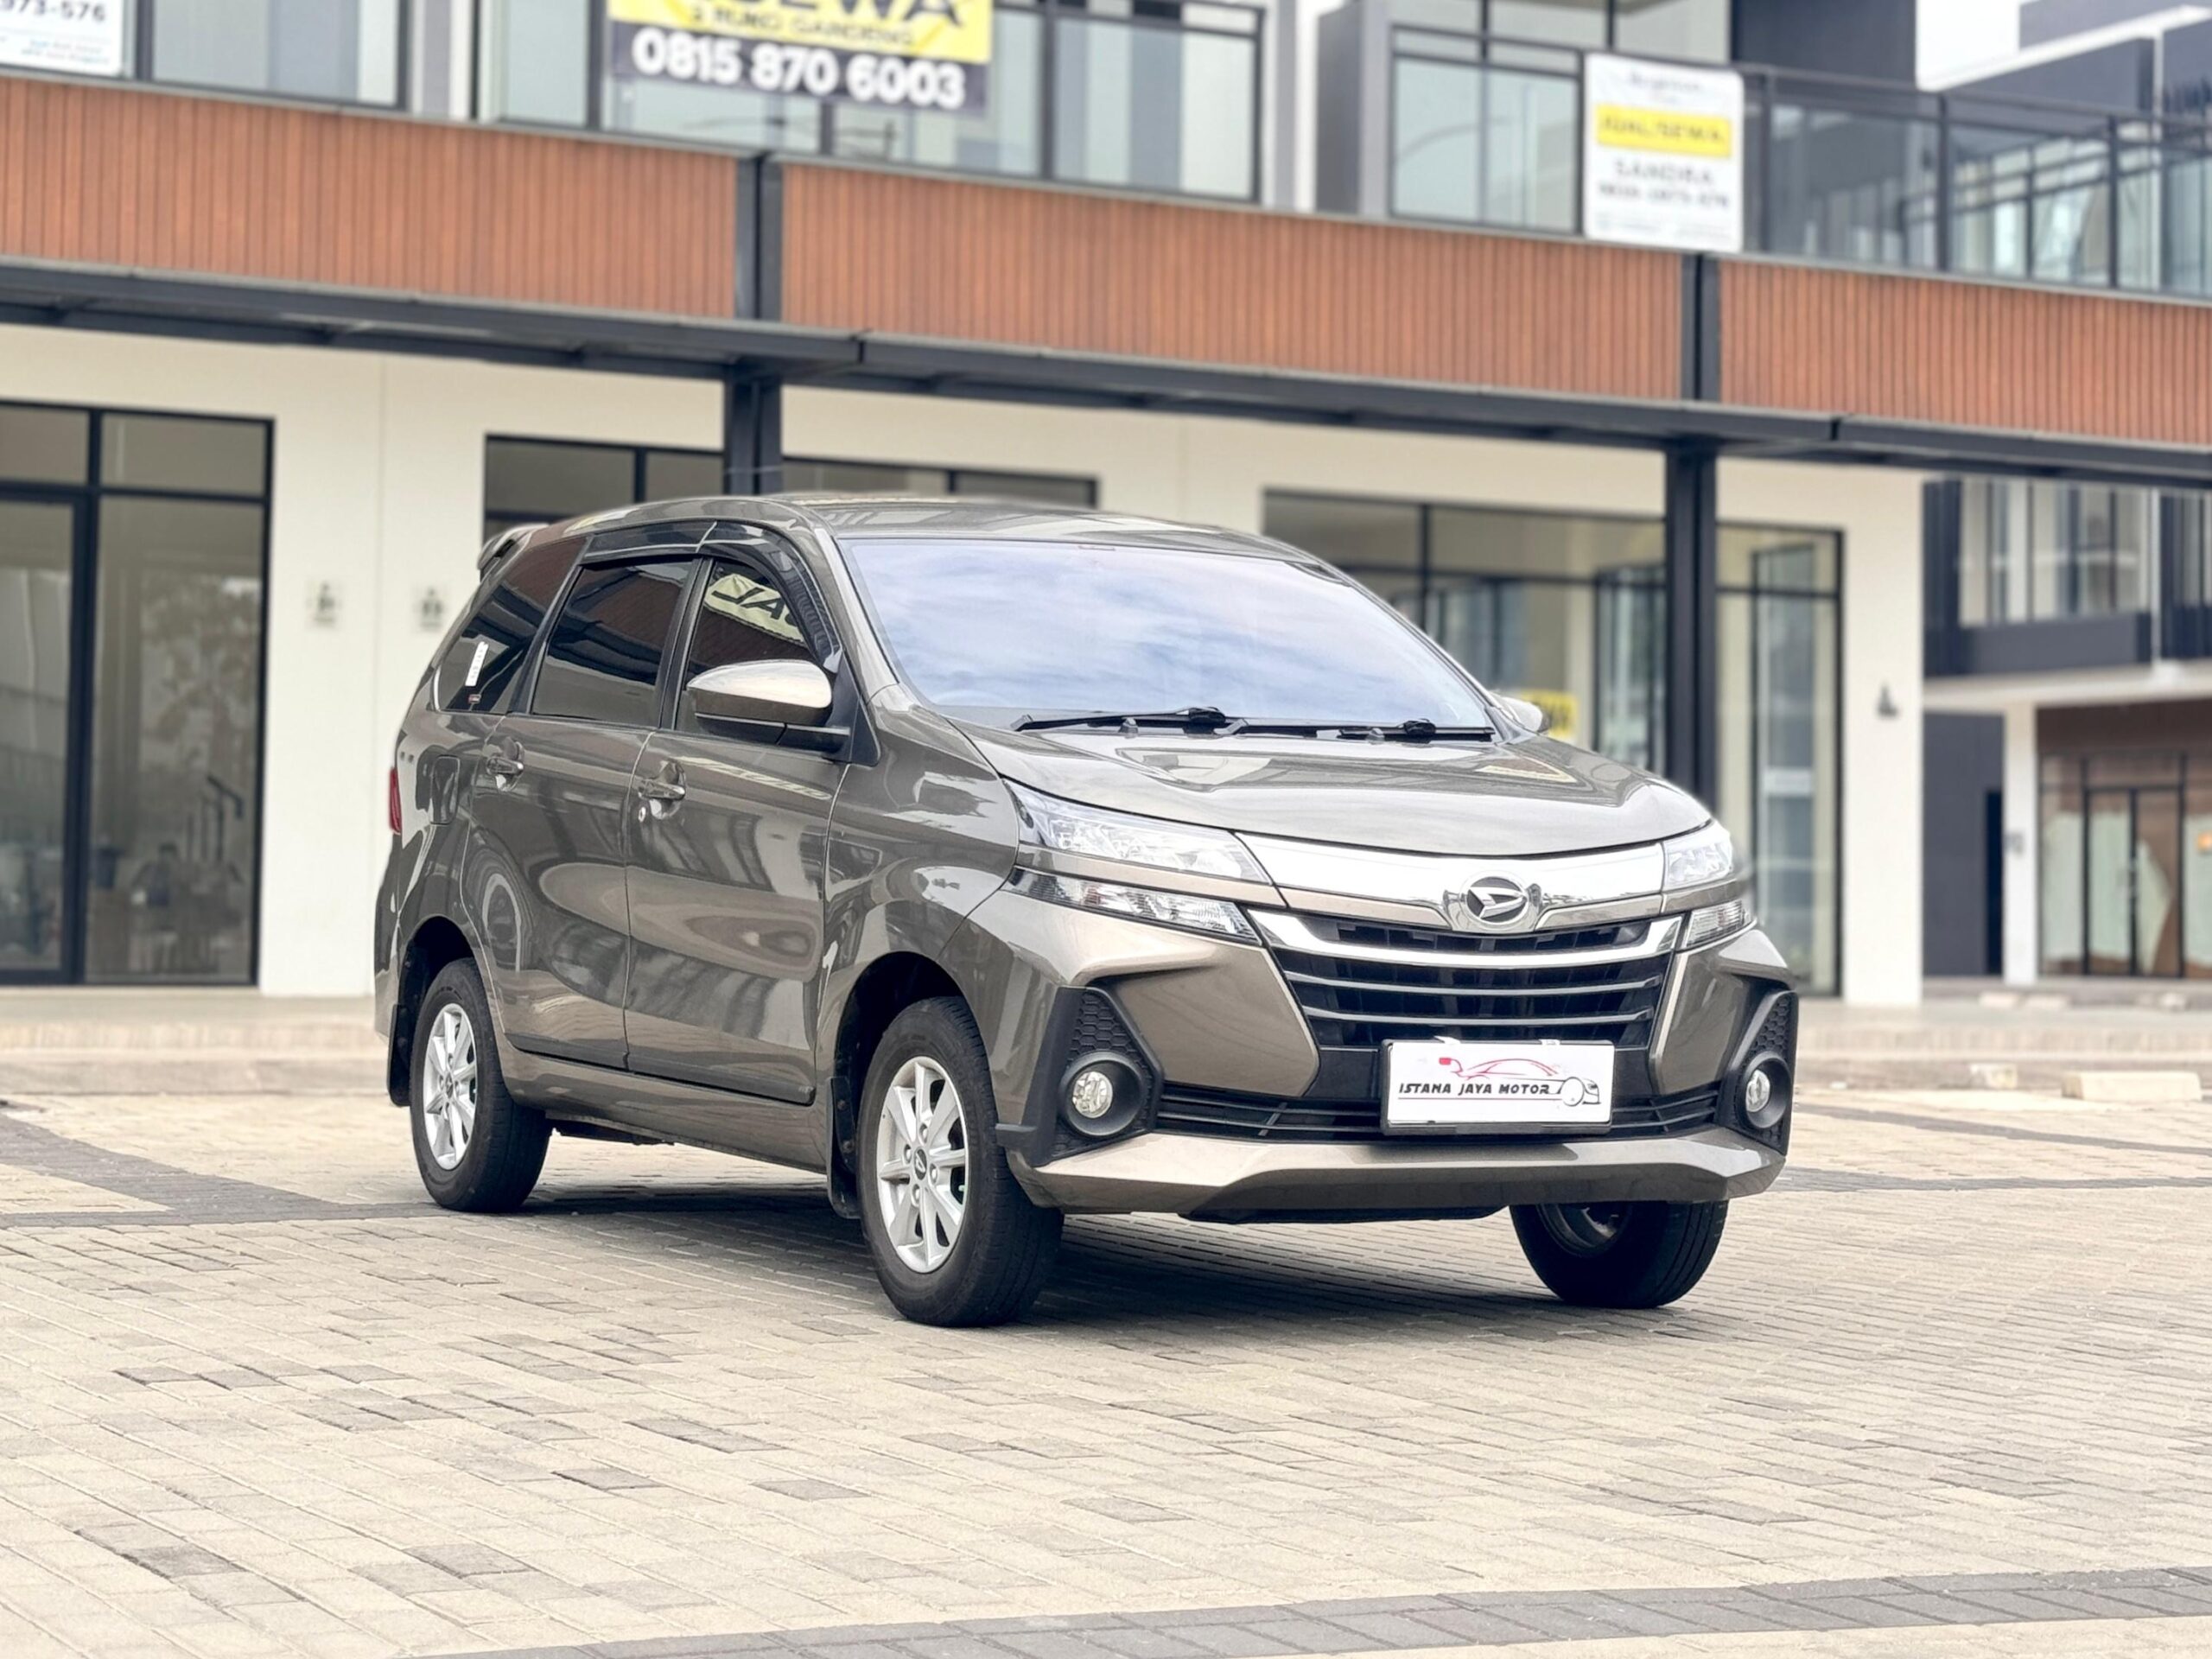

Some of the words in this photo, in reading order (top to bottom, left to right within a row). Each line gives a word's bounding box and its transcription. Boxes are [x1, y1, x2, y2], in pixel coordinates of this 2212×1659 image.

[631, 28, 742, 85] 0815
[750, 43, 840, 96] 870
[846, 54, 967, 110] 6003
[1399, 1083, 1452, 1094] ISTANA
[1458, 1083, 1492, 1096] JAYA
[1498, 1084, 1550, 1095] MOTOR
